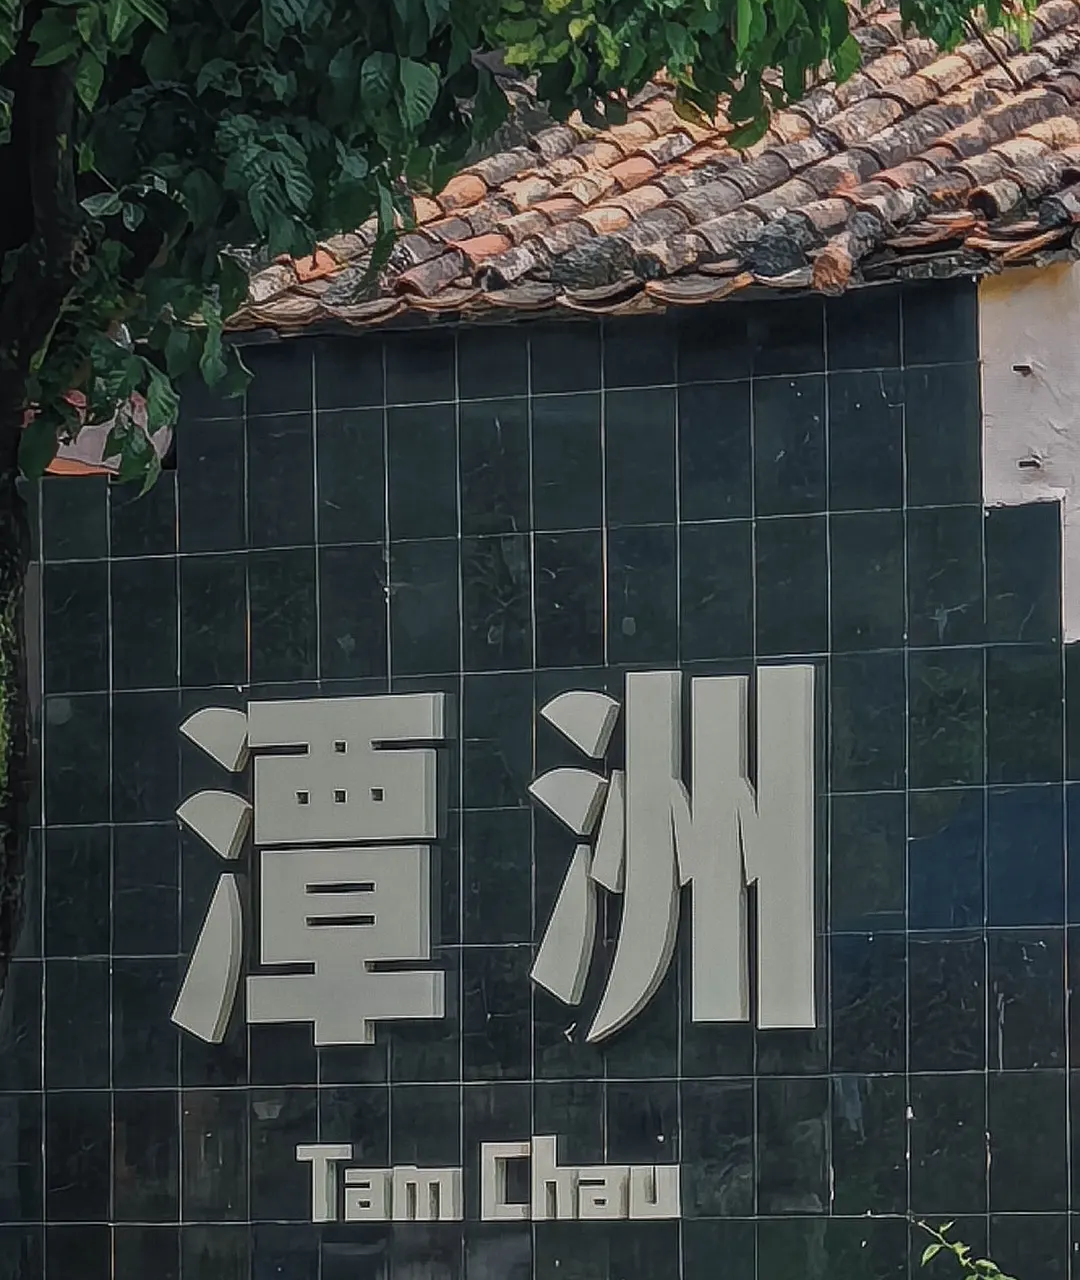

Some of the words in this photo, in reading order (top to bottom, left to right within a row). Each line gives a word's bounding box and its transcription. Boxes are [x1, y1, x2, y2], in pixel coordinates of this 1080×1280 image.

[171, 664, 817, 1045] 潭洲
[296, 1143, 463, 1222] Tam
[481, 1136, 681, 1222] Chau
